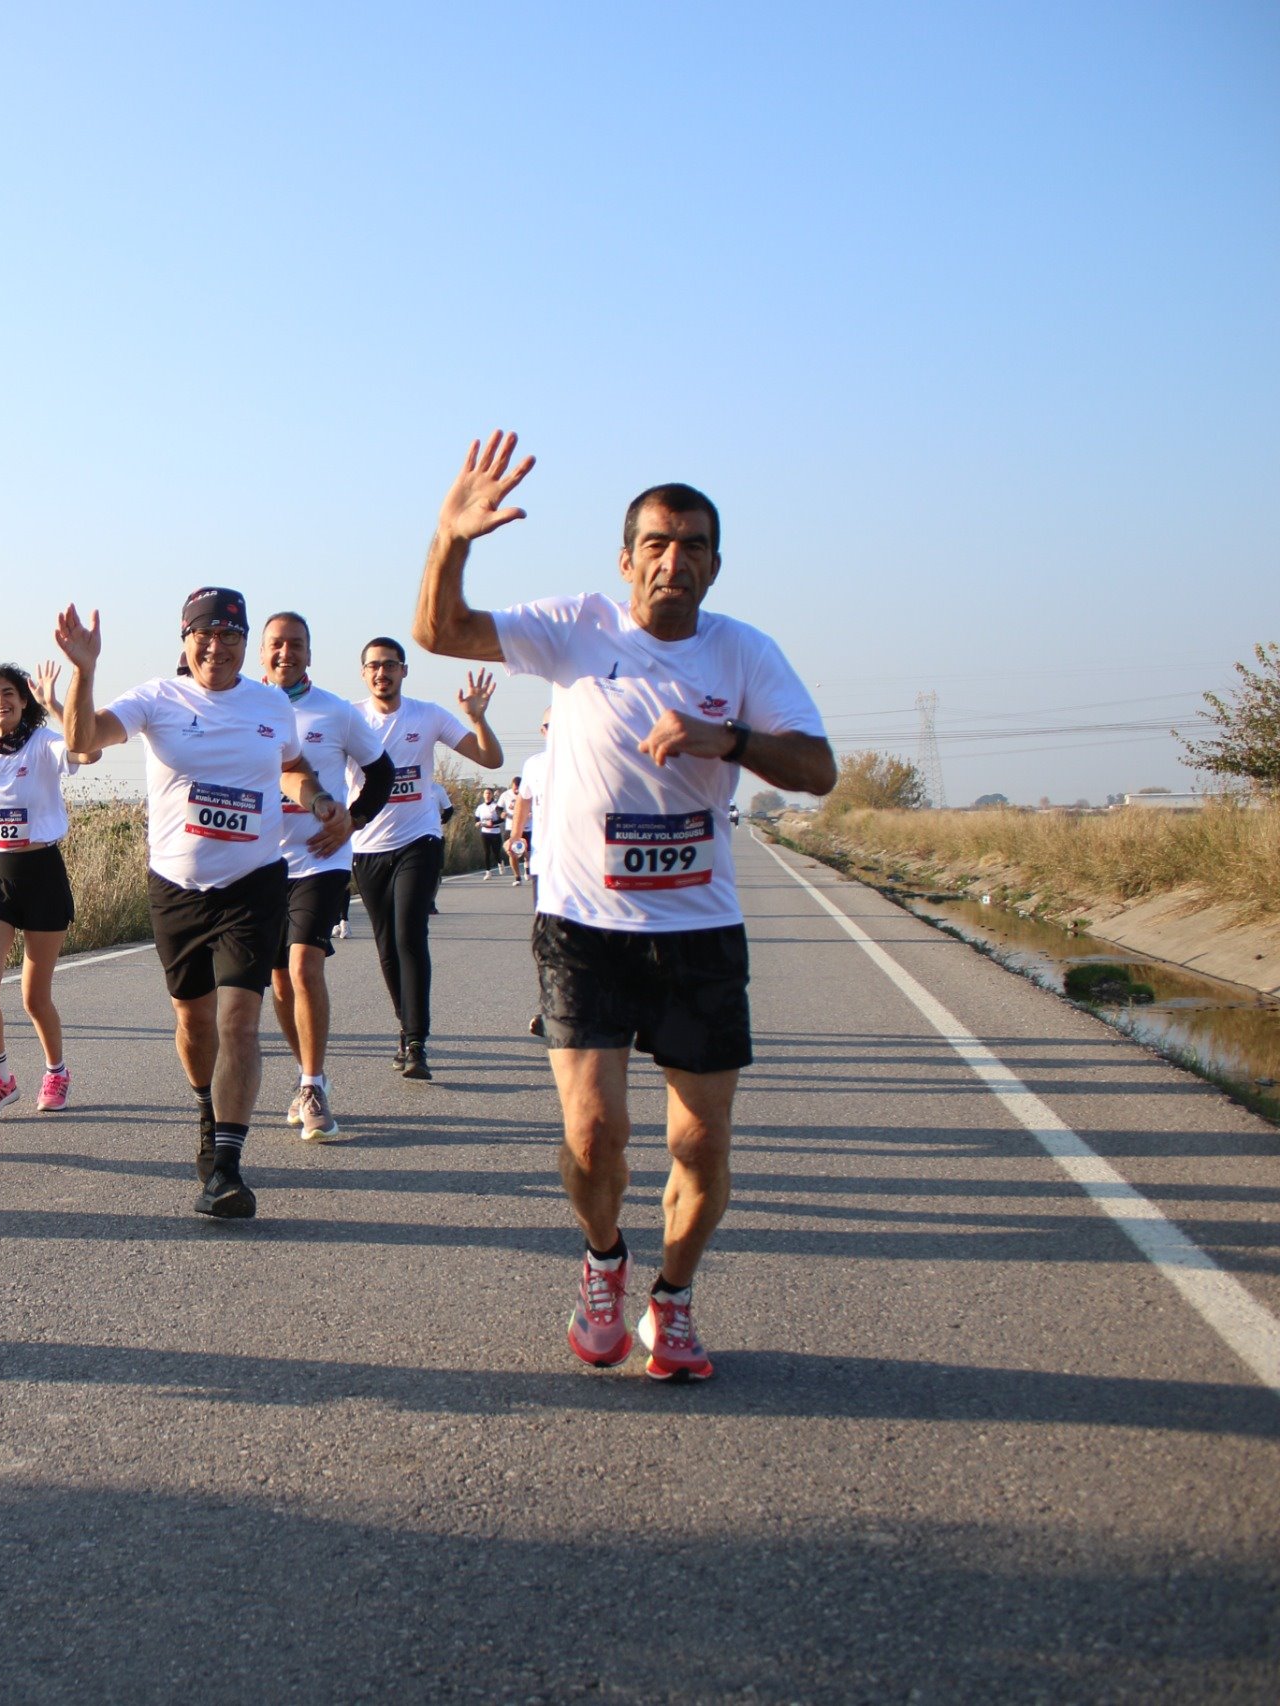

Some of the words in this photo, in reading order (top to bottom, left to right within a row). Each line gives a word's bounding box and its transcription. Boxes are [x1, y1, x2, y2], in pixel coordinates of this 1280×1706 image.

[392, 781, 414, 794] 201
[199, 808, 247, 831] 0061
[615, 830, 653, 840] KUBİLAY
[673, 828, 705, 840] KOŞUSU
[624, 846, 697, 872] 0199
